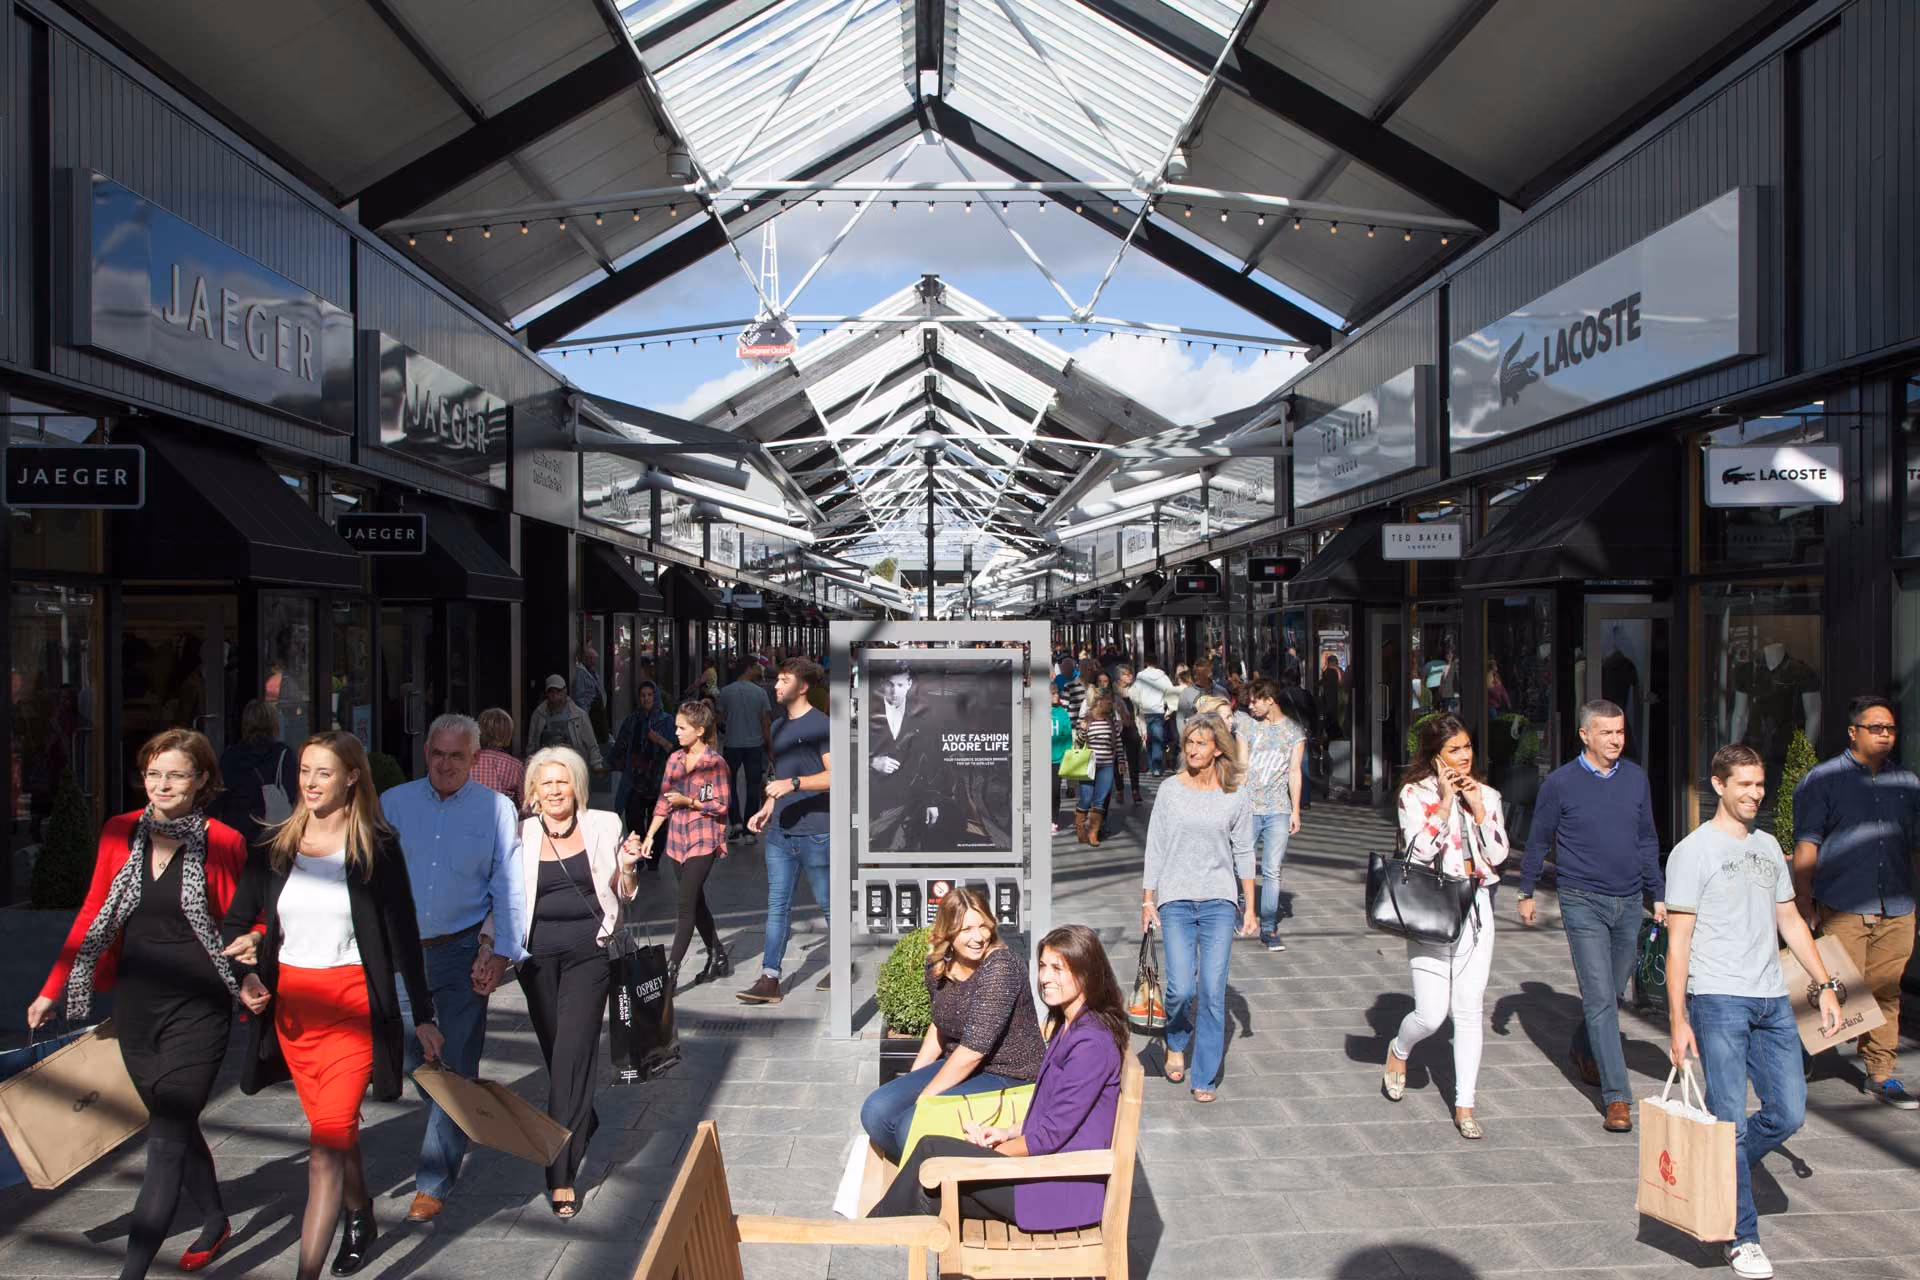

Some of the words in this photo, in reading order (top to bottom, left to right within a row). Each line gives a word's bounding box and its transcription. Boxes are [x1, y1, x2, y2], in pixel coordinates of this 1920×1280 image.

[163, 263, 314, 382] JAEGER
[1543, 291, 1642, 377] LACOSTE
[412, 383, 487, 455] JAEGER
[1321, 428, 1337, 454] TED
[1342, 409, 1373, 447] BAKER
[17, 467, 128, 486] JAEGER
[1759, 468, 1828, 481] LACOSTE
[344, 527, 417, 540] JAEGER
[1391, 533, 1411, 543] TED
[1418, 532, 1453, 542] BAKER
[941, 733, 966, 742] LOVE
[968, 733, 1009, 742] FASHION
[942, 741, 982, 752] ADORE
[984, 741, 1009, 751] LIFE
[636, 975, 663, 998] OSPREY
[643, 991, 662, 1004] LONDON
